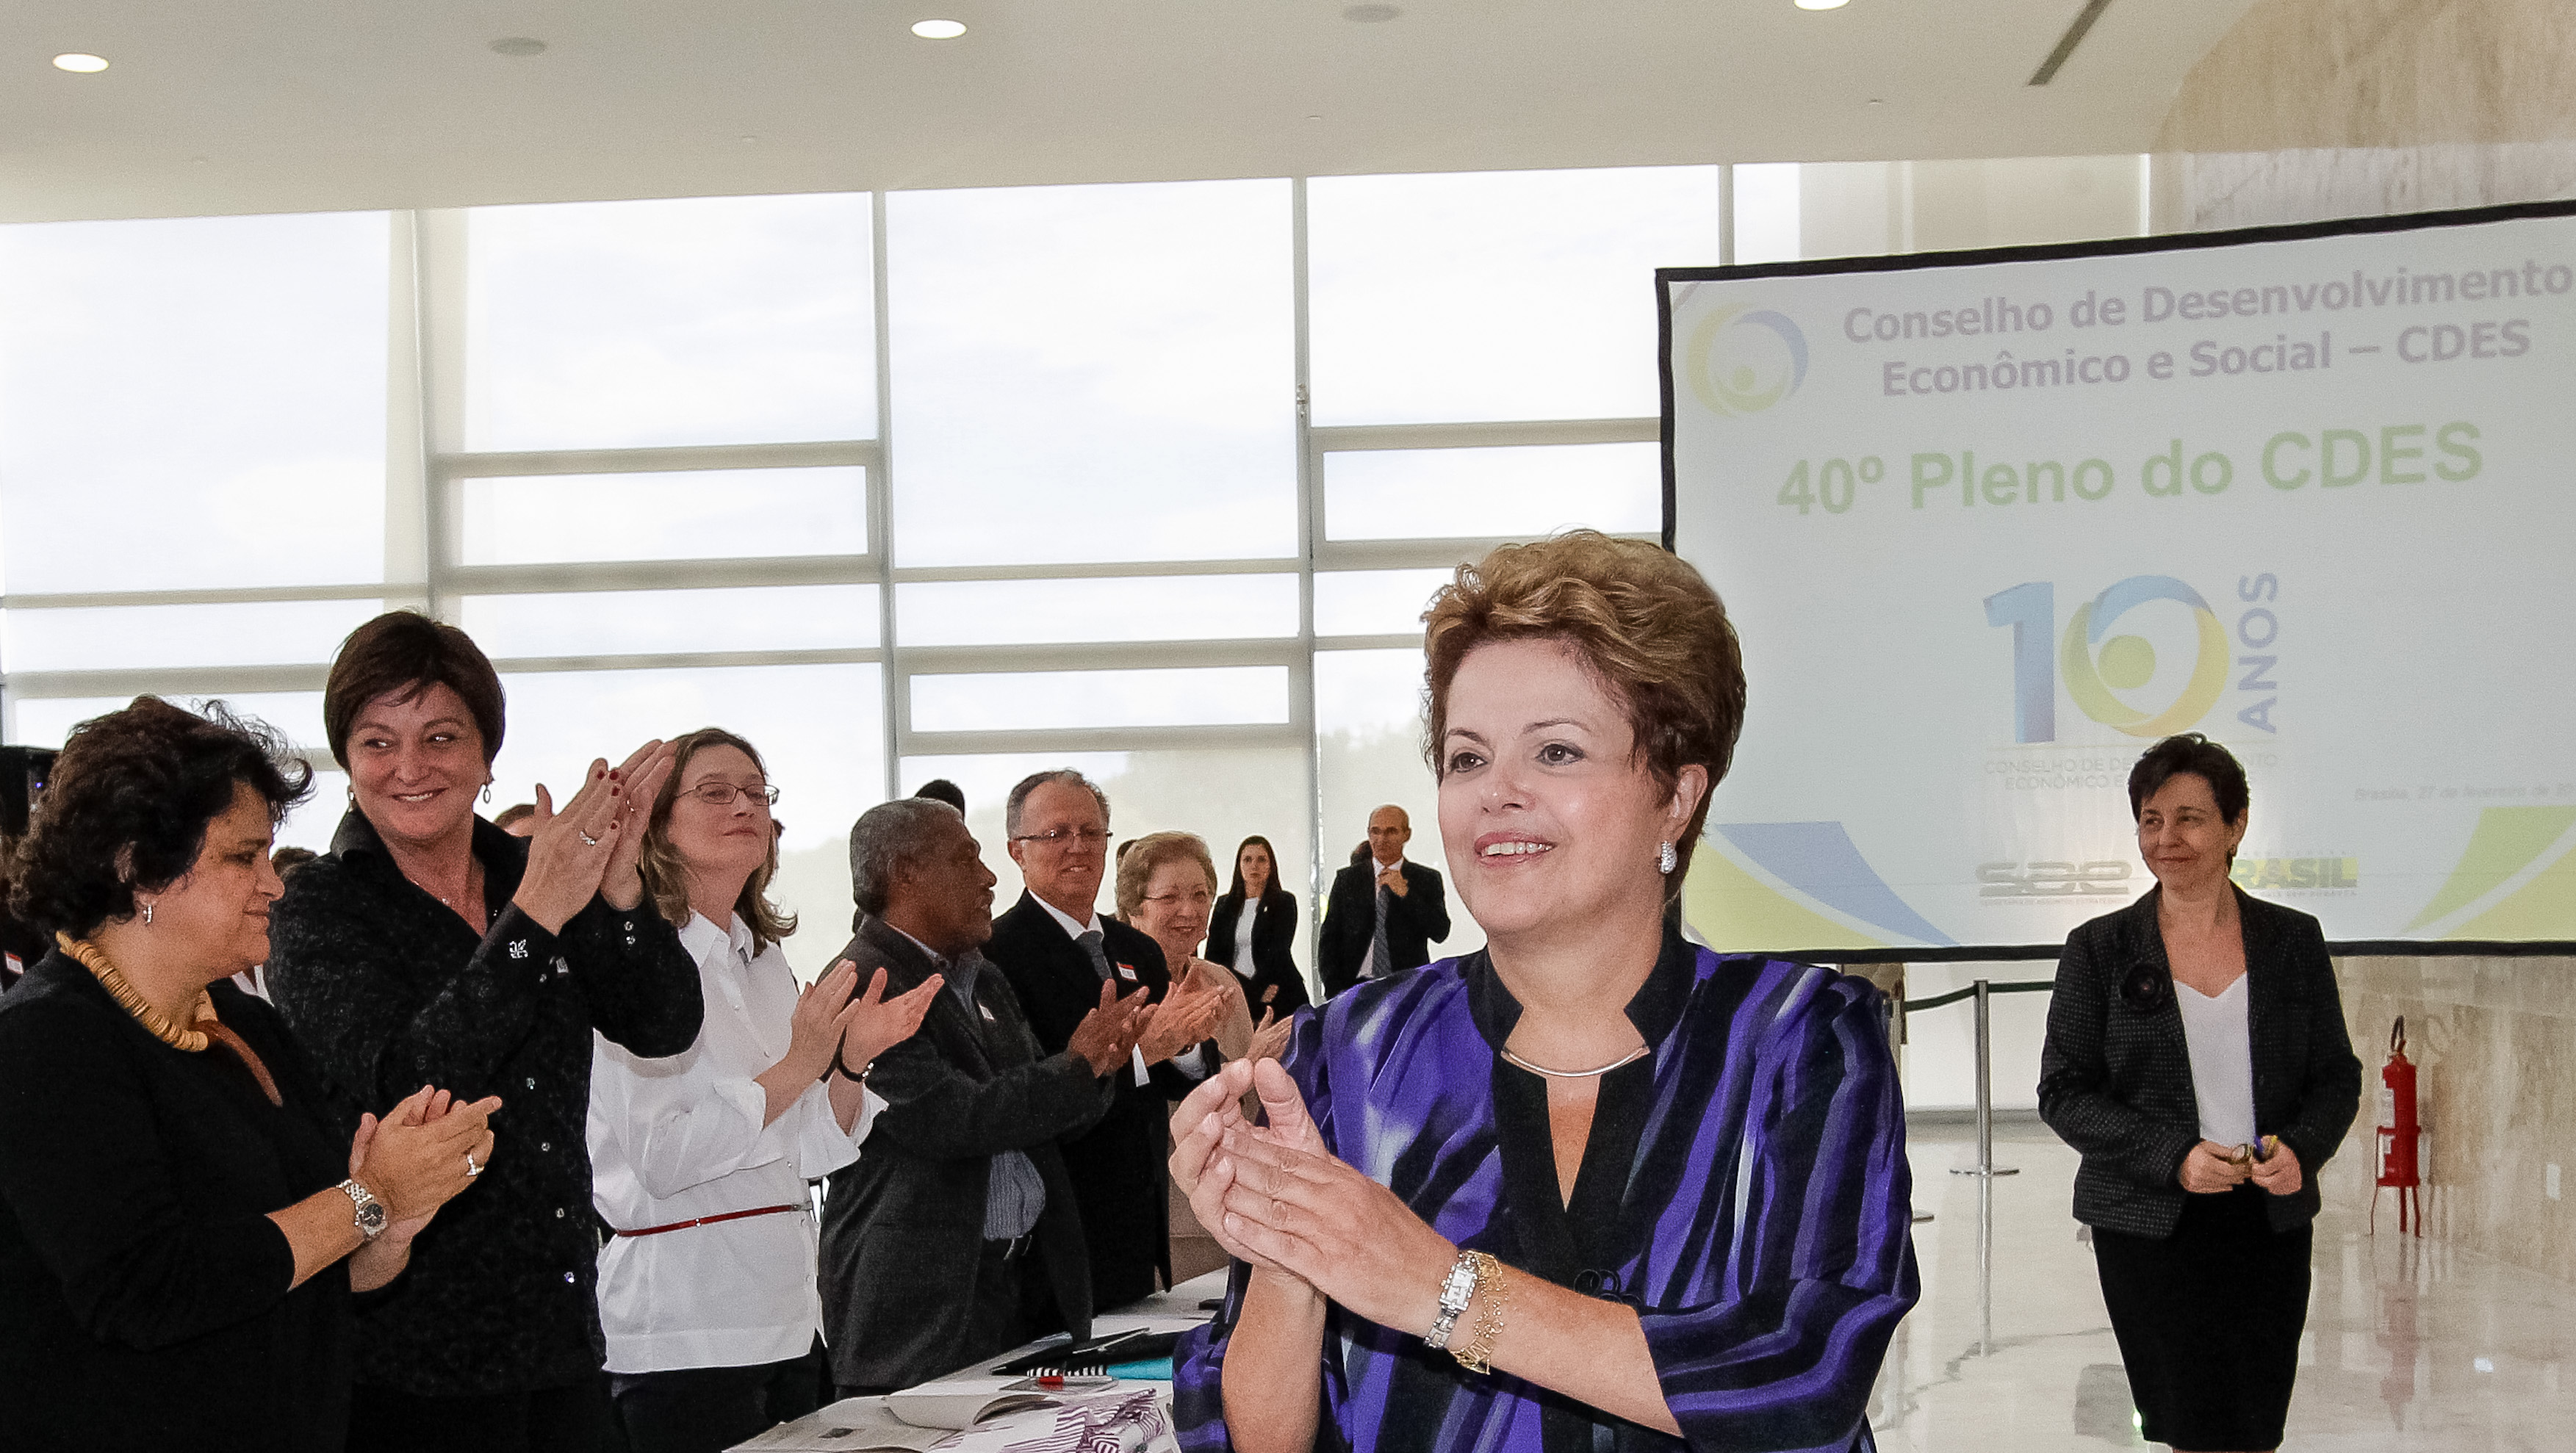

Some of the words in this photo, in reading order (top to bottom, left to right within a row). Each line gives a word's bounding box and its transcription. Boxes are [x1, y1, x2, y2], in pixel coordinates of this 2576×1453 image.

[1843, 296, 2054, 343] Conselho
[2069, 290, 2127, 328] de
[2143, 259, 2573, 322] Desenvolvimento
[1883, 348, 2131, 396] Econômico
[2146, 350, 2175, 380] e
[2189, 331, 2331, 378] Social
[2397, 320, 2531, 364] CDES
[1911, 450, 2115, 510] Pleno
[2140, 439, 2233, 498] do
[2260, 422, 2483, 491] CDES
[2237, 572, 2279, 734] ANOS
[1985, 757, 2076, 774] CONSELHO
[2082, 757, 2104, 771] DE
[2004, 774, 2110, 790] ECONÔMICO
[2228, 858, 2358, 889] RASIL
